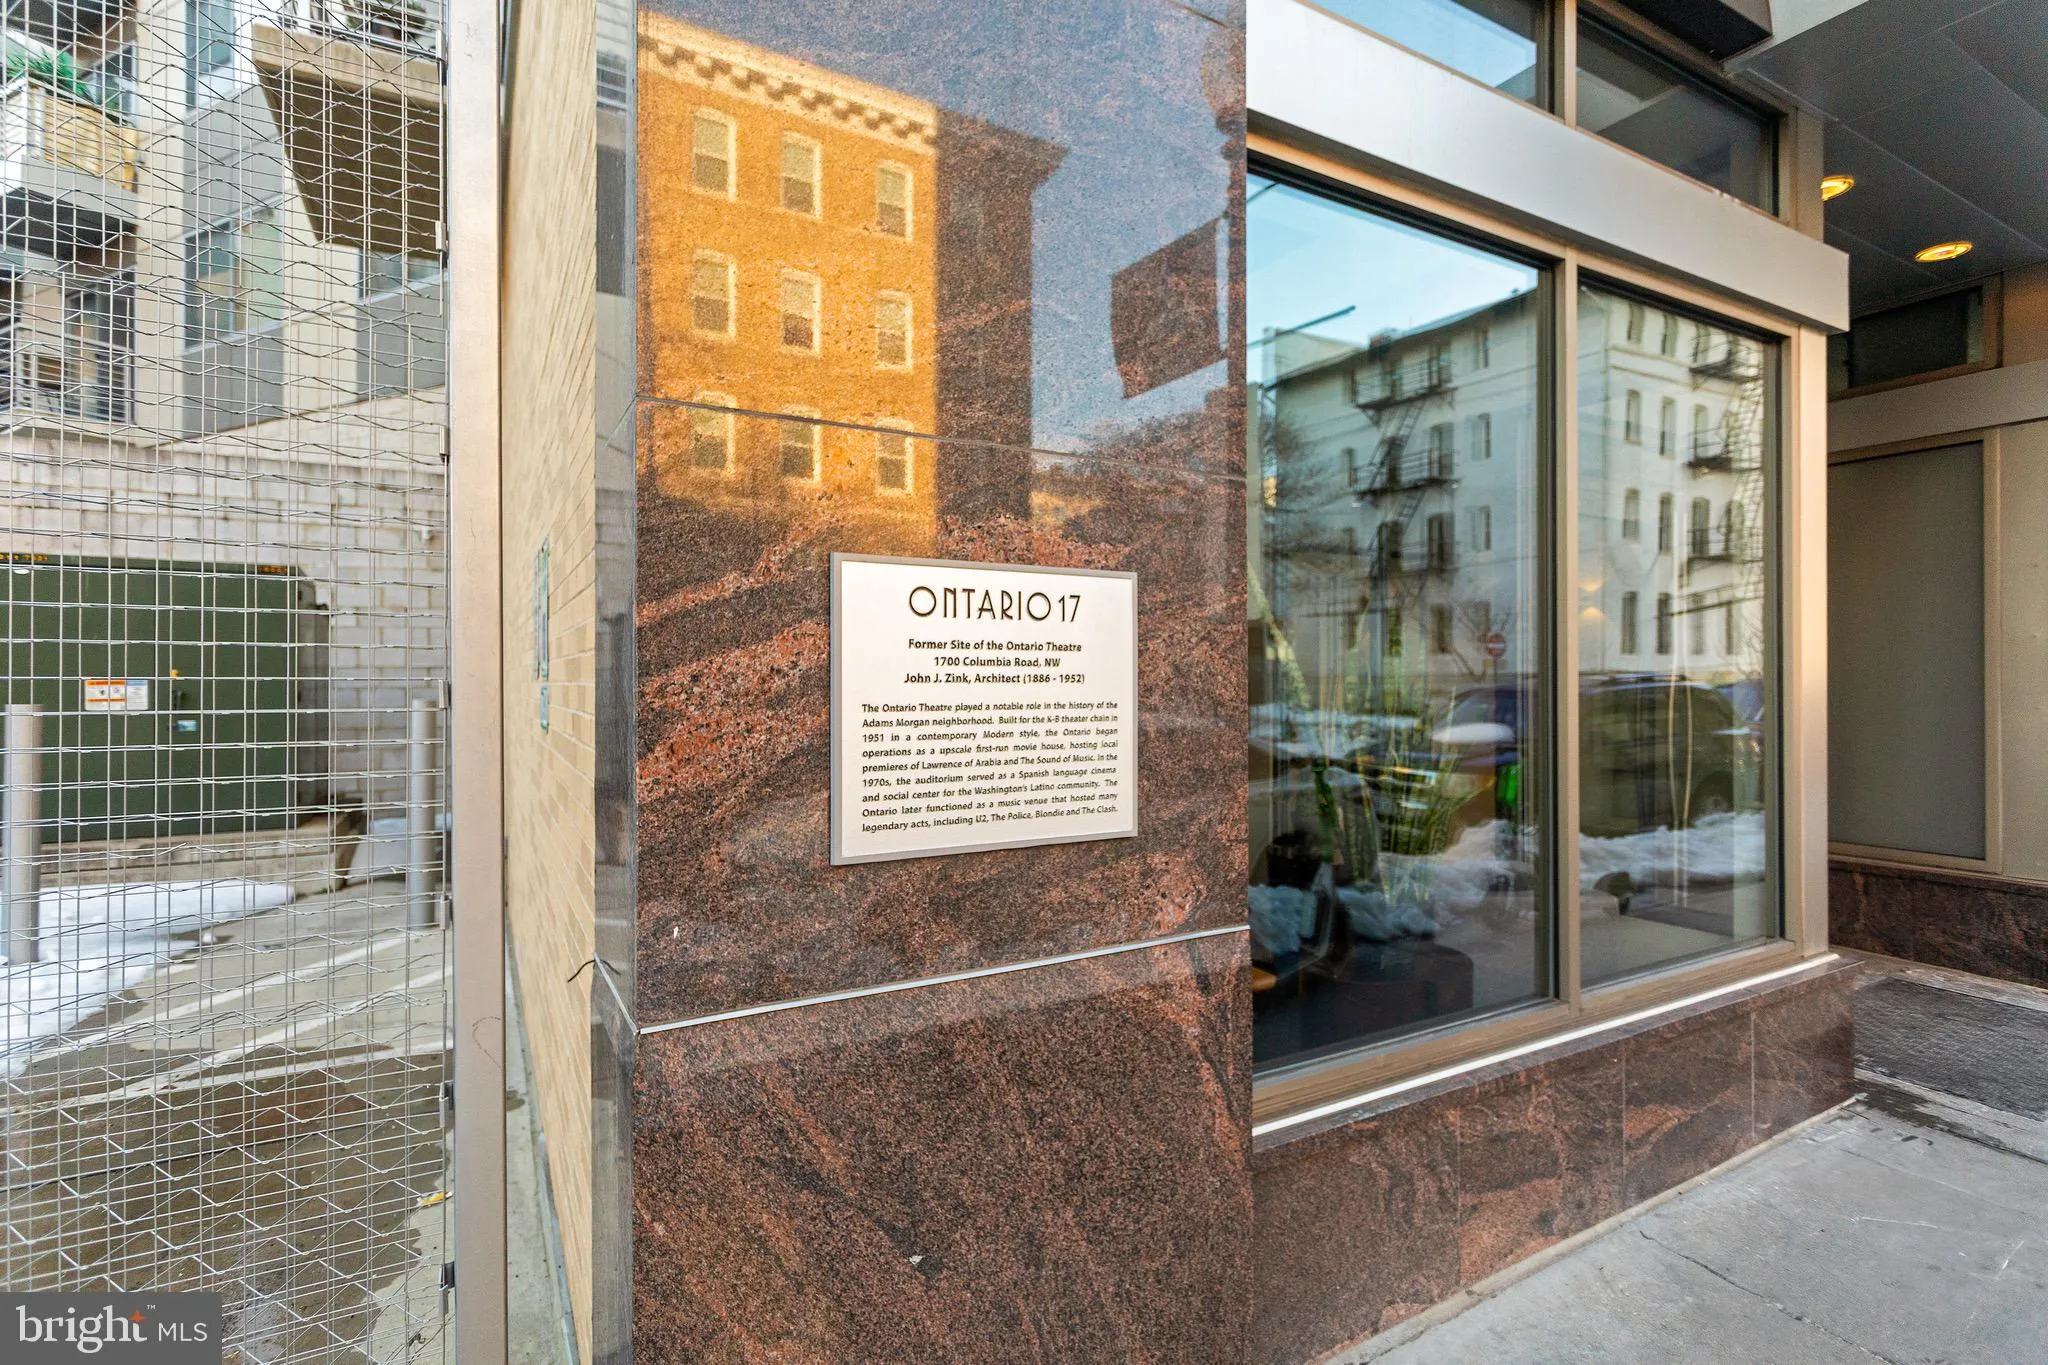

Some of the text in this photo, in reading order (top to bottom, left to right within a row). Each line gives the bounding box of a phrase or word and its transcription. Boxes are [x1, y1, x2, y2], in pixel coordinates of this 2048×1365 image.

[908, 638, 1082, 652] Former Site of the Ontario Theatre
[934, 656, 1061, 668] 1700 Columbia Road, NW
[904, 673, 931, 683] John
[933, 673, 942, 683] J.
[944, 673, 972, 684] Zink,
[974, 673, 1020, 683] Architect
[1023, 674, 1051, 684] (1886
[1059, 674, 1085, 684] 1952)
[861, 704, 879, 713] The
[882, 703, 917, 713] Ontario
[918, 703, 952, 712] Theatre
[955, 702, 983, 713] played
[993, 702, 1024, 710] notable
[1026, 701, 1041, 710] role
[1053, 701, 1066, 709] the
[1068, 701, 1095, 711] history
[1096, 701, 1104, 709] of
[1106, 701, 1118, 709] the
[862, 718, 894, 728] Adams
[895, 718, 930, 729] Morgan
[932, 716, 994, 728] neighborhood.
[998, 715, 1017, 724] Built
[1019, 715, 1031, 724] for
[1032, 715, 1045, 724] the
[1061, 715, 1088, 723] theater
[1090, 714, 1110, 722] chain
[862, 733, 884, 743] 1951
[891, 733, 900, 742] in
[916, 732, 978, 742] contemporary
[983, 730, 1014, 739] Modern
[1063, 728, 1091, 736] Ontario
[1096, 728, 1118, 737] began
[862, 748, 912, 760] operations
[939, 745, 972, 756] upscale
[976, 744, 1009, 753] first-run
[1013, 743, 1037, 751] movie
[1070, 741, 1098, 750] hosting
[1101, 740, 1118, 748] local
[862, 763, 908, 775] premieres
[910, 761, 920, 770] of
[922, 761, 962, 770] Lawrence
[964, 758, 974, 768] of
[975, 758, 1002, 767] Arabia
[1003, 757, 1019, 766] and
[1020, 756, 1035, 764] The
[1036, 755, 1061, 764] Sound
[1062, 755, 1071, 763] of
[1106, 753, 1118, 761] the
[862, 778, 892, 787] 1970s,
[896, 777, 911, 786] the
[914, 774, 963, 785] auditorium
[967, 772, 995, 782] served
[1018, 769, 1049, 780] Spanish
[1053, 769, 1088, 778] language
[1090, 767, 1116, 775] cinema
[862, 792, 880, 803] and
[883, 791, 909, 801] social
[912, 790, 940, 799] center
[943, 789, 955, 797] for
[957, 787, 972, 796] the
[1030, 783, 1055, 792] Latino
[862, 807, 898, 817] Ontario
[901, 806, 923, 815] later
[925, 801, 973, 813] functioned
[998, 798, 1021, 807] music
[1051, 795, 1067, 804] that
[1070, 793, 1095, 802] hosted
[1098, 793, 1118, 801] many
[862, 821, 909, 834] legendary
[910, 820, 931, 828] acts,
[933, 816, 973, 826] including
[975, 814, 989, 823] U2,
[990, 813, 1006, 822] The
[1035, 809, 1065, 818] Blondie
[1066, 807, 1080, 816] and
[1081, 806, 1095, 814] The
